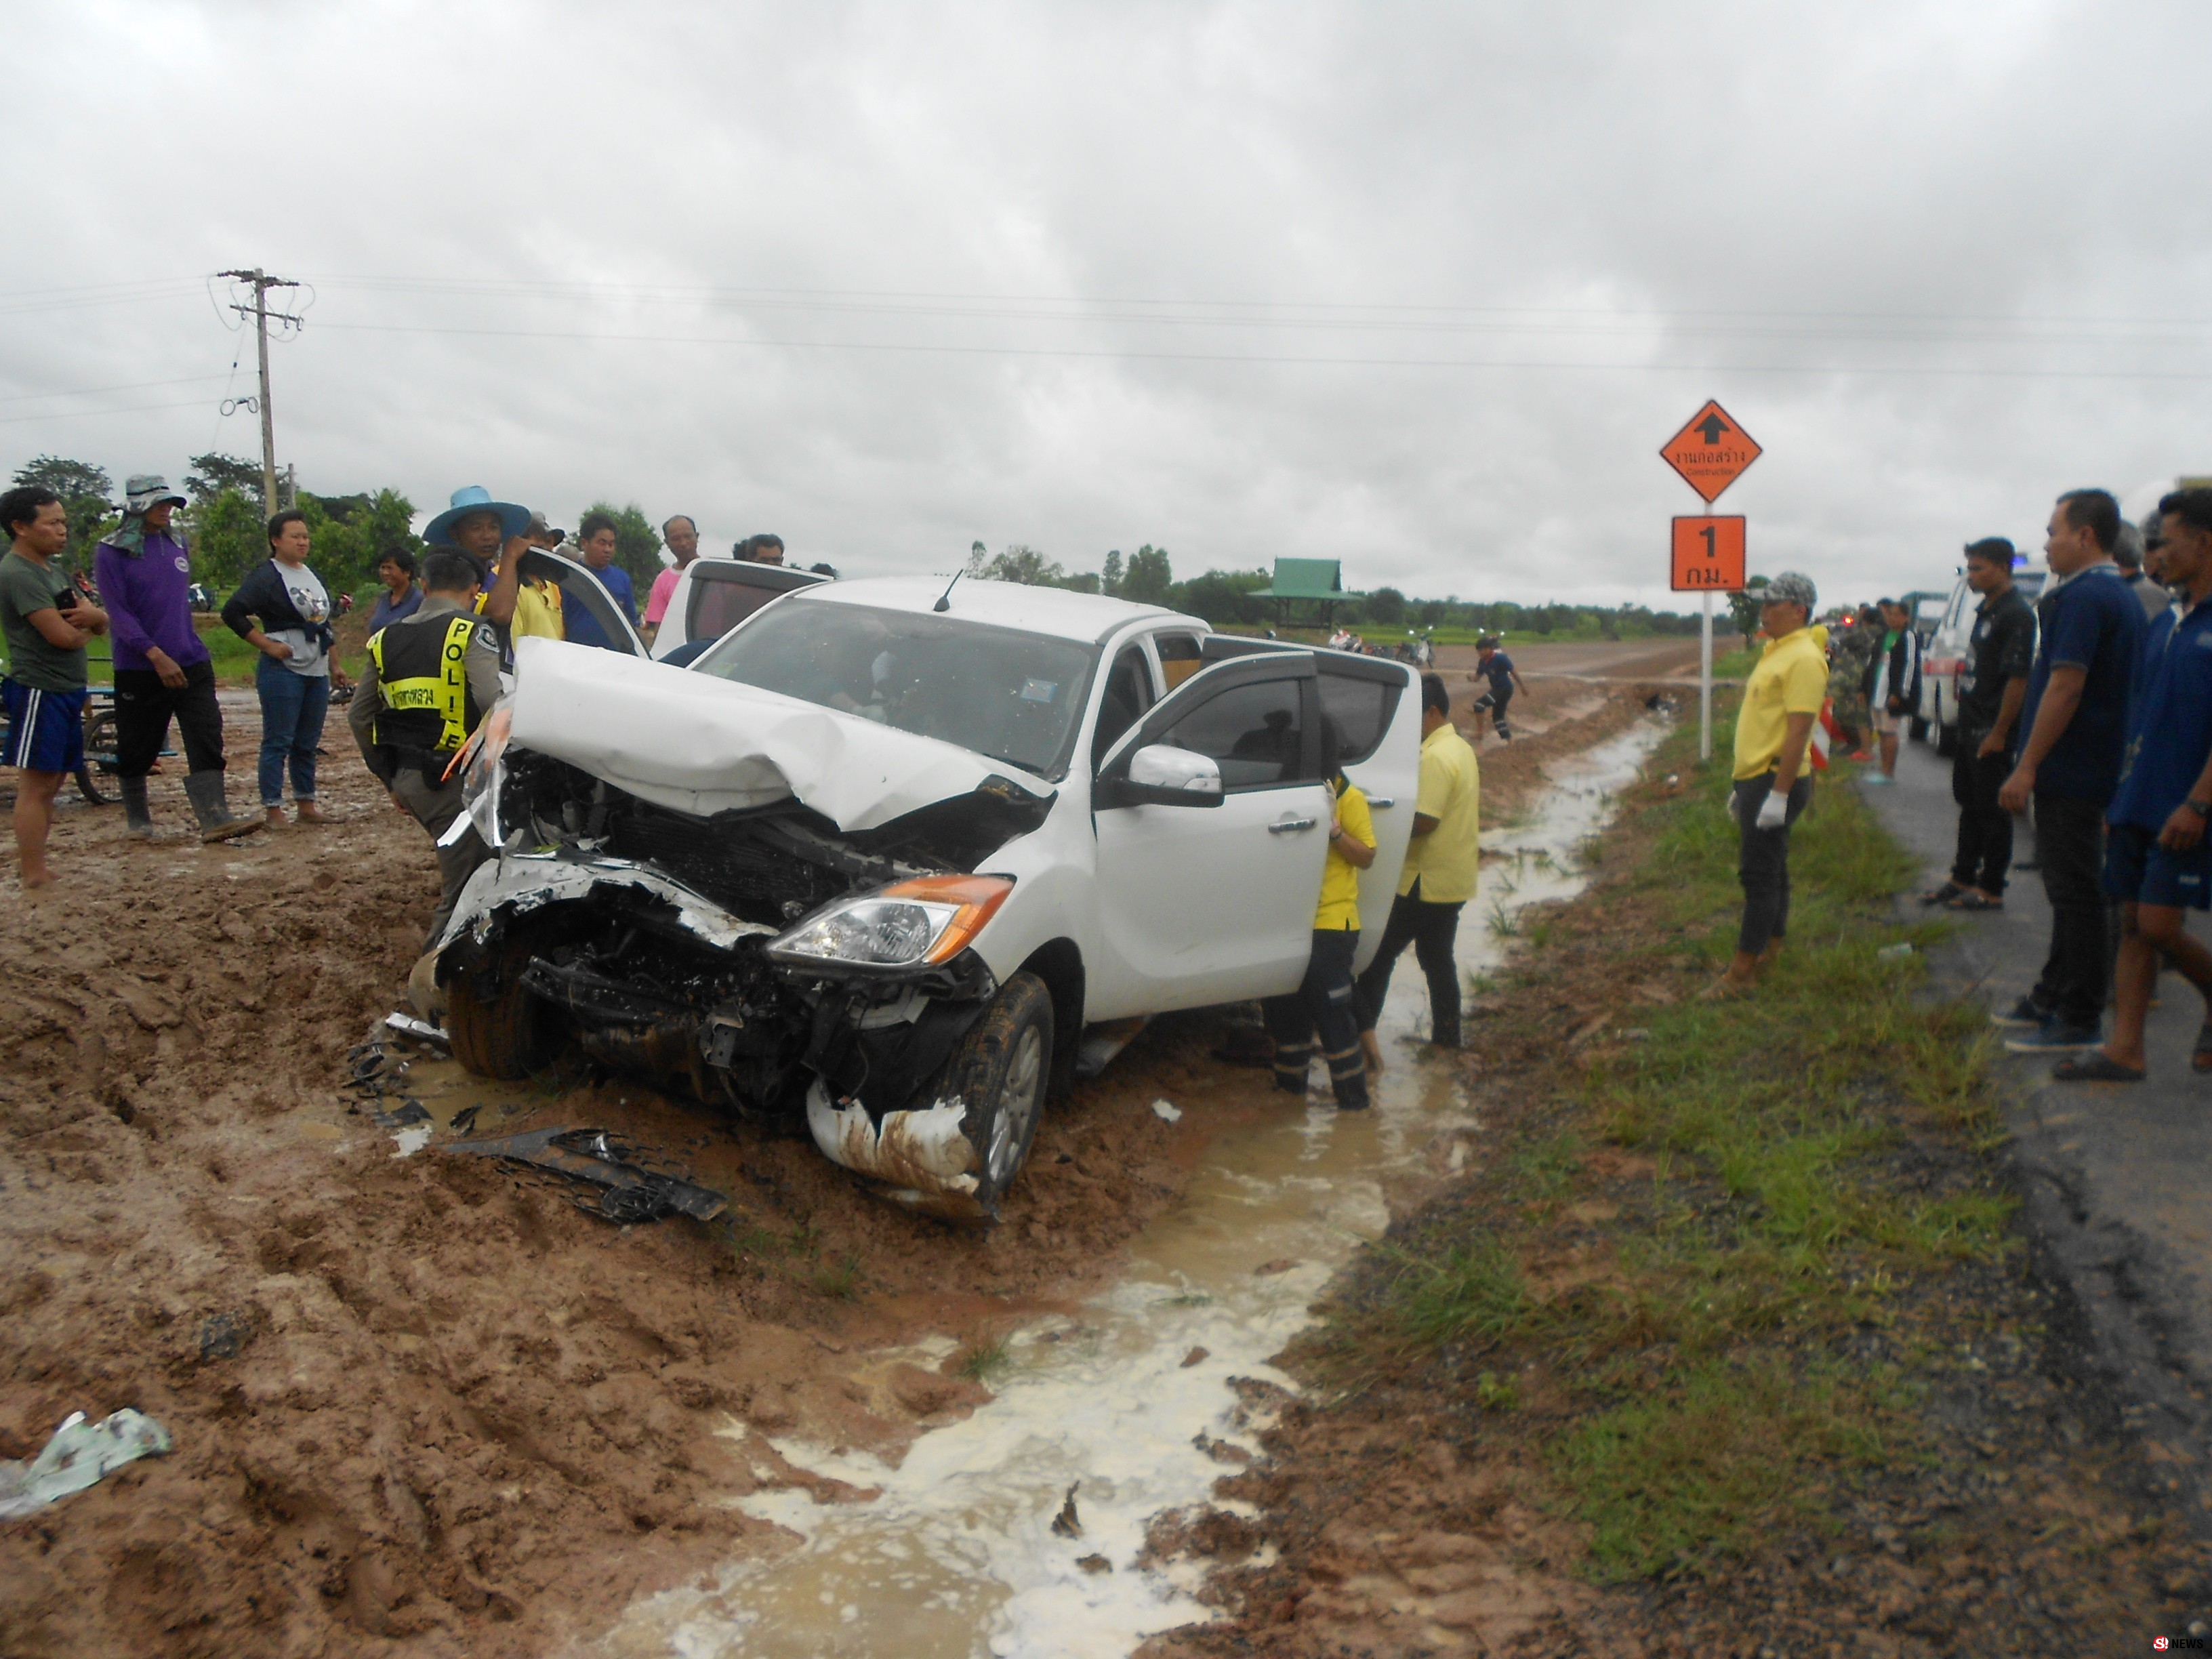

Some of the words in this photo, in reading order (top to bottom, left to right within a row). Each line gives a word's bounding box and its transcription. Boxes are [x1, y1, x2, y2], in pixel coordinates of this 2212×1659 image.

[1675, 447, 1746, 464] งานก่อสร้าง
[1686, 468, 1735, 476] Construction
[1699, 527, 1715, 558] 1
[1686, 568, 1728, 584] กม.
